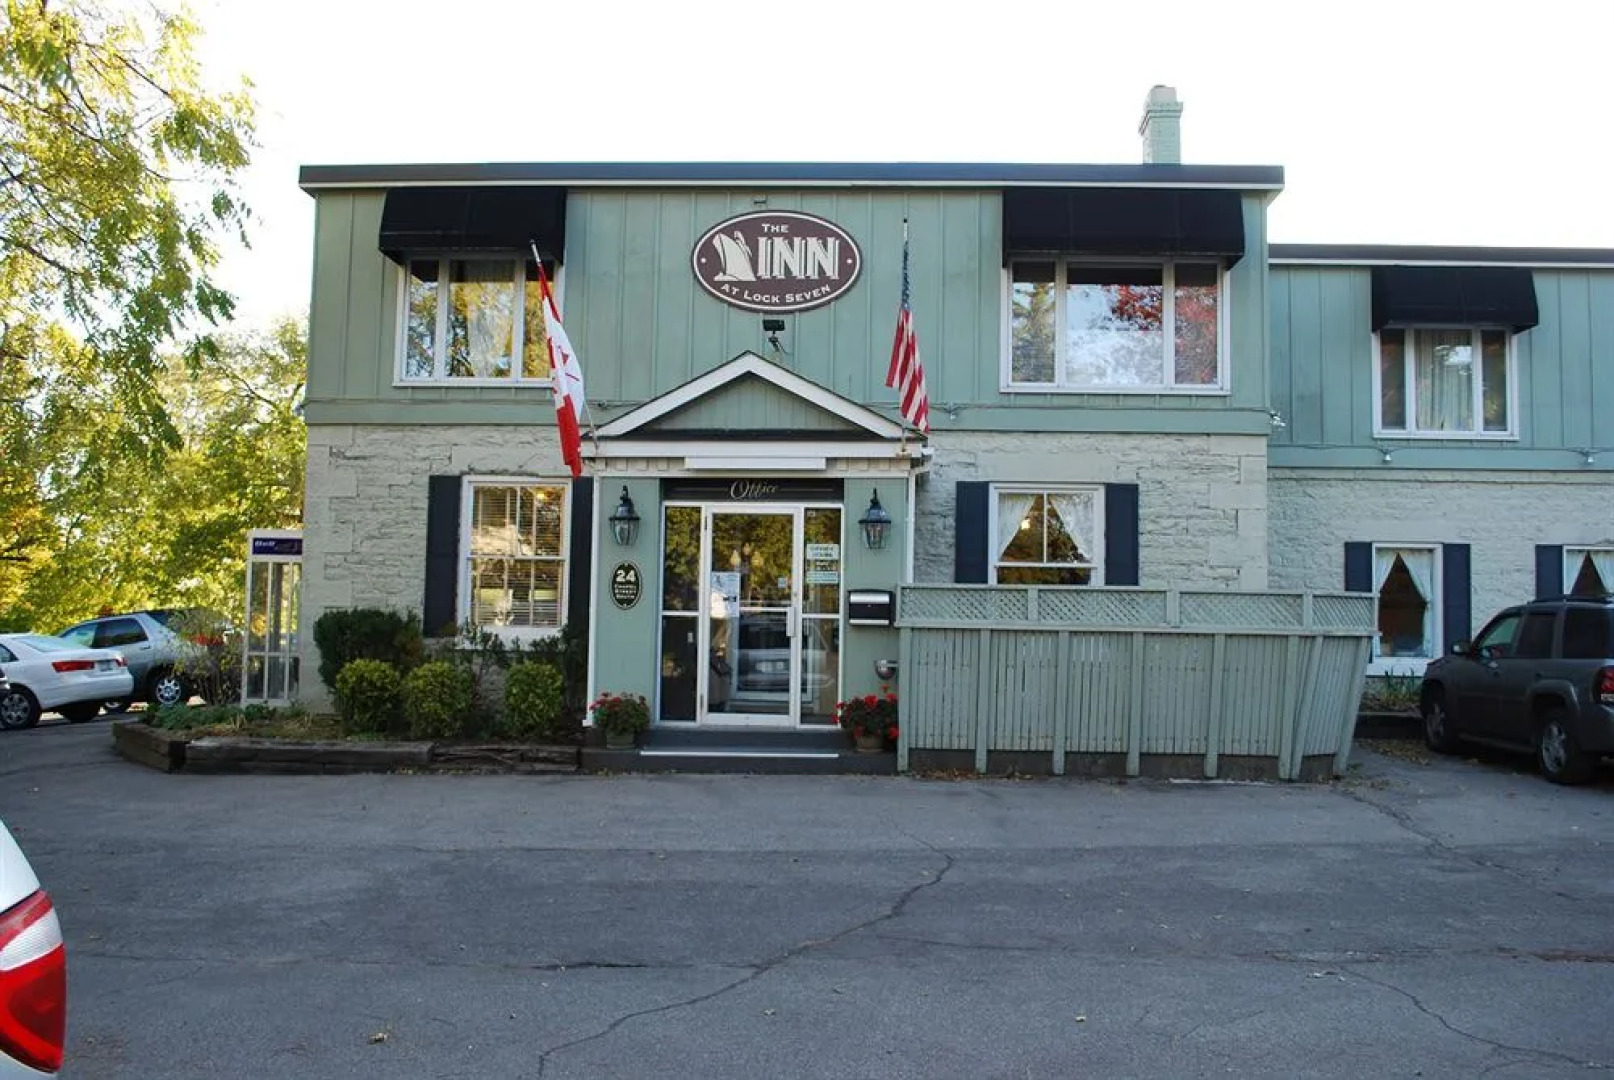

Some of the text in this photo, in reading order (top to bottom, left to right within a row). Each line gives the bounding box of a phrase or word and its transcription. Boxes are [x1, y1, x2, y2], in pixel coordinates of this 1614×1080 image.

[762, 223, 789, 233] THE
[757, 236, 840, 280] INN
[720, 283, 831, 303] AT LOCK SEVEN
[730, 479, 777, 500] Office
[616, 569, 636, 582] 24
